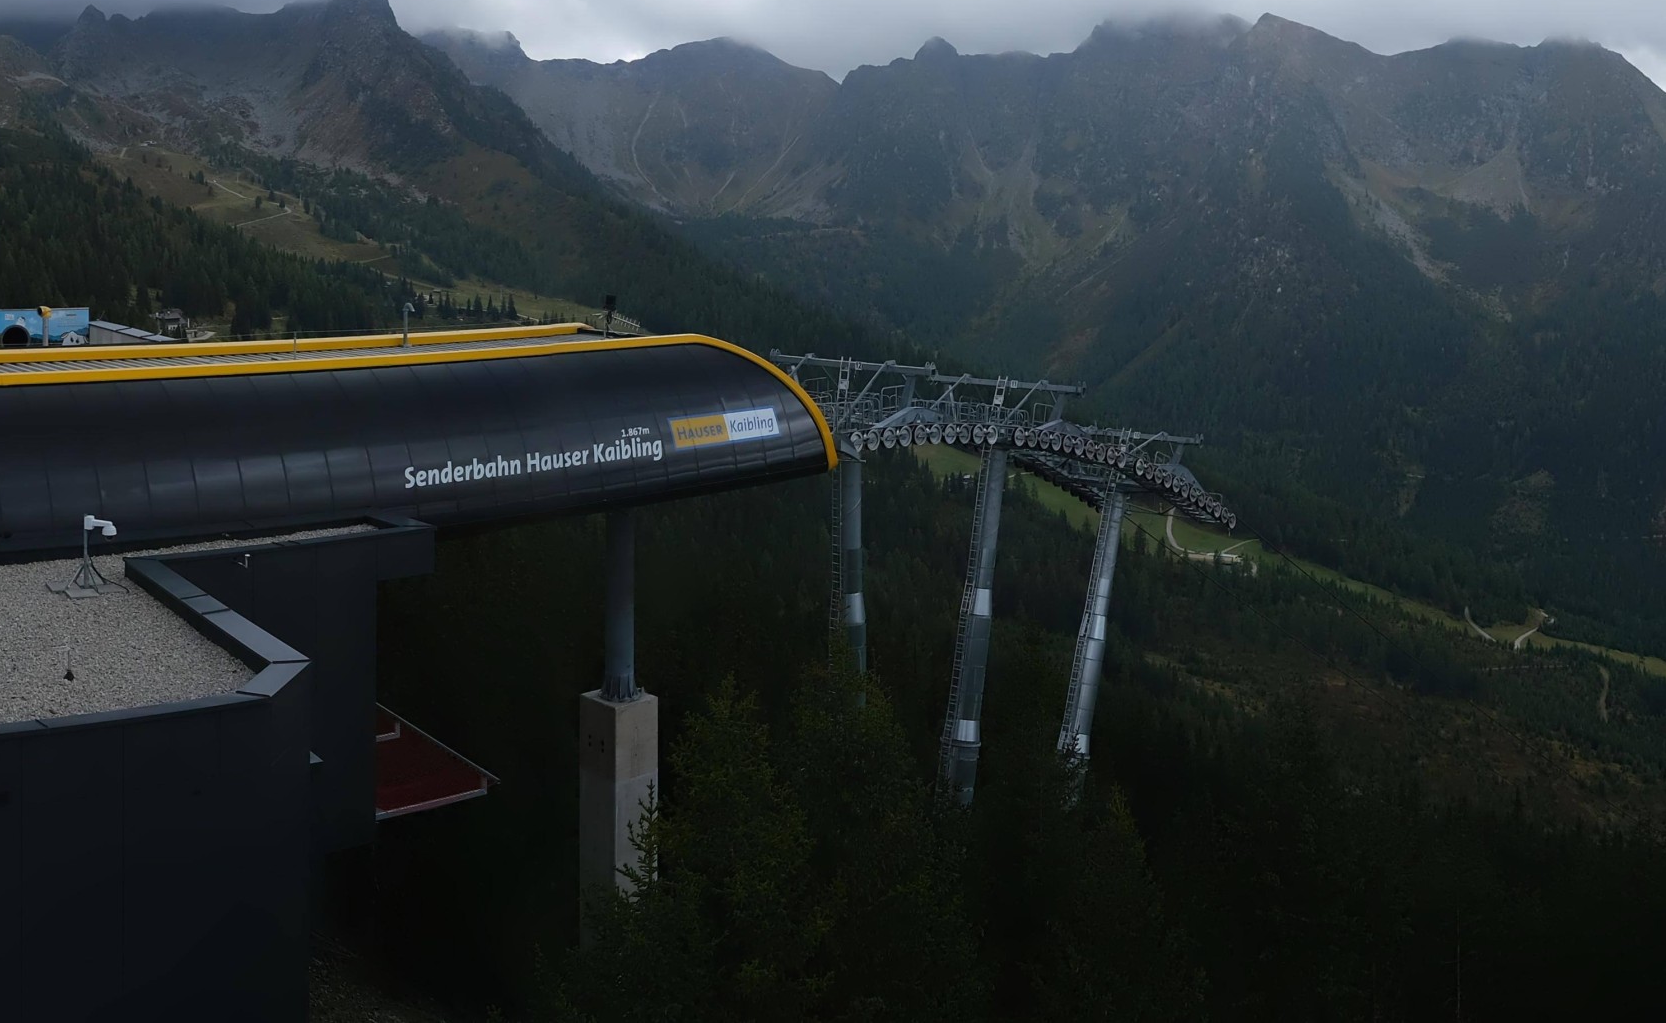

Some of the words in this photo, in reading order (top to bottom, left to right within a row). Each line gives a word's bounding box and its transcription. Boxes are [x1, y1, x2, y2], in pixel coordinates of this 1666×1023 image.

[620, 426, 650, 438] 1.867m
[676, 423, 723, 441] HAUSER
[730, 415, 774, 434] Kaibling
[404, 455, 521, 489] Senderbahn
[526, 447, 590, 475] Hauser
[593, 437, 663, 464] Kaibling
